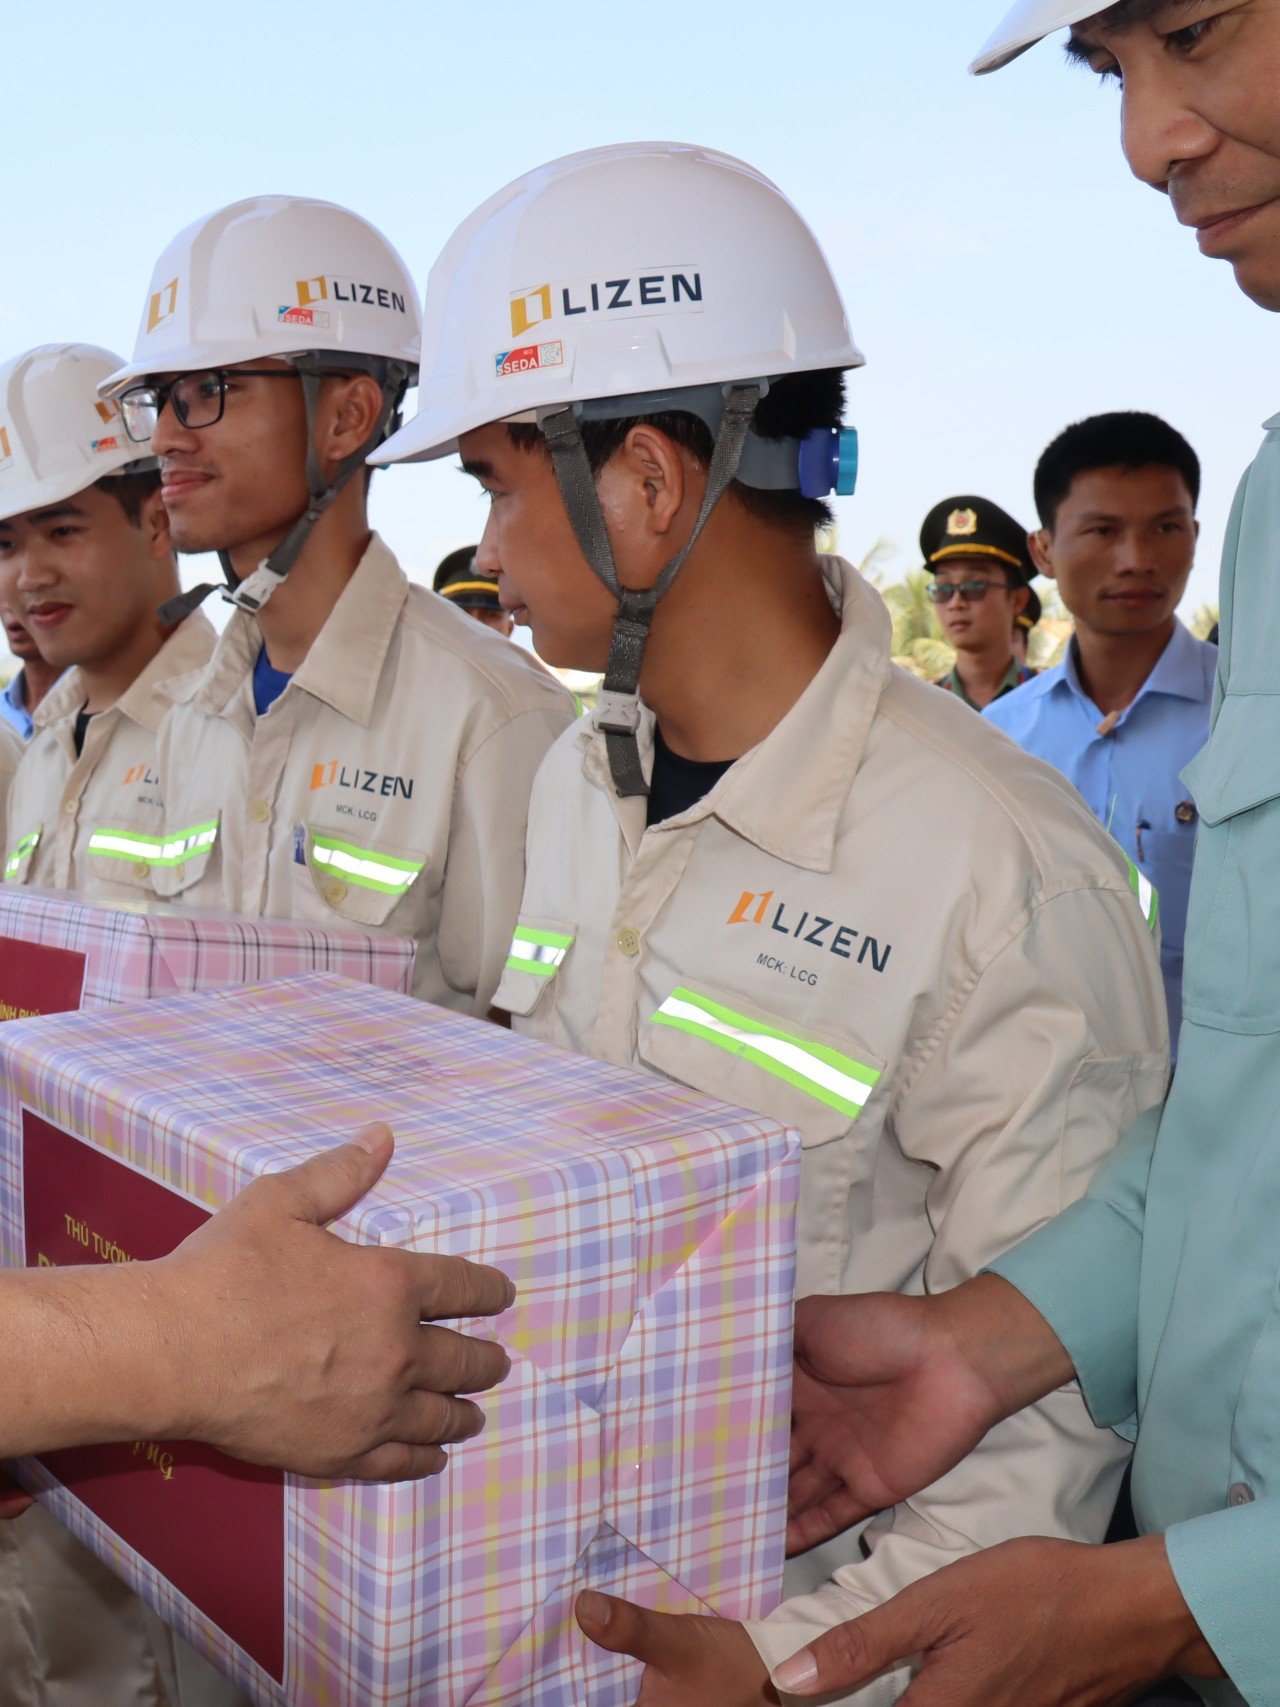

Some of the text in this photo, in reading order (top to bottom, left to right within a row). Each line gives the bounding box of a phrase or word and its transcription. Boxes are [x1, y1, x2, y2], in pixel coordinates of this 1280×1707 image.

[333, 281, 406, 314] LIZEN
[563, 273, 702, 316] LIZEN
[340, 766, 413, 799] LIZEN
[358, 809, 377, 822] LCG
[771, 902, 892, 973] LIZEN
[756, 953, 818, 986] MCK: LCG
[64, 1213, 89, 1246] THỦ
